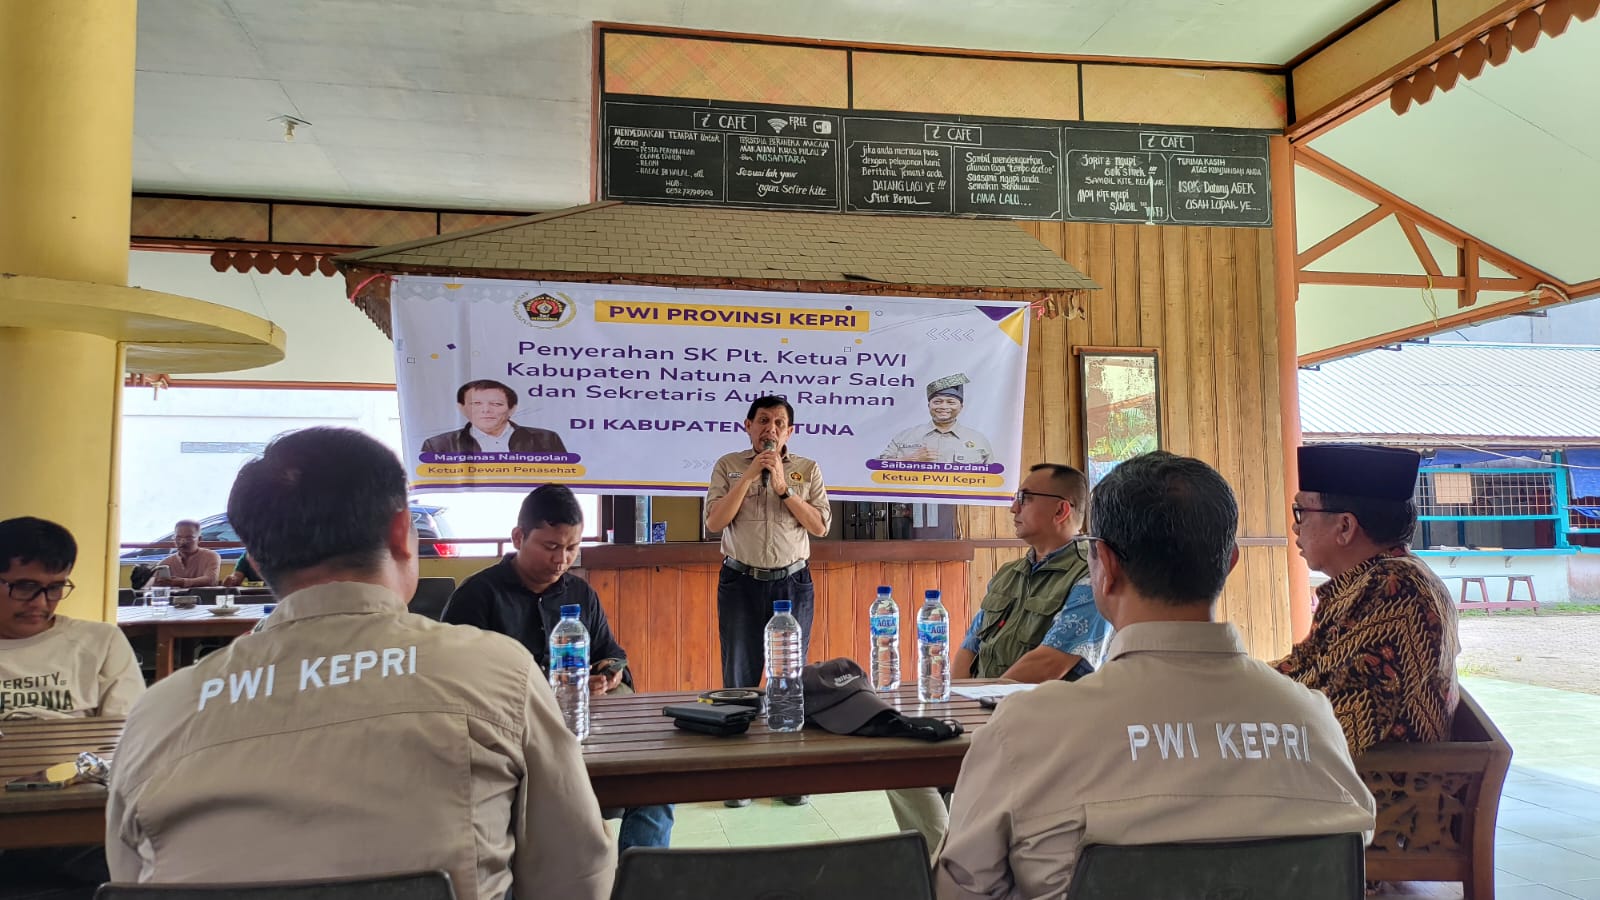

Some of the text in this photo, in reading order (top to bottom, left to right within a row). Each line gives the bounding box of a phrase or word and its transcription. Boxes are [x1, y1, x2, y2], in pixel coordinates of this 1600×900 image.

[719, 115, 748, 130] CAFE
[789, 116, 808, 130] FREE
[614, 128, 664, 139] MENYEDIAKAN
[668, 131, 698, 141] TEMPAT
[947, 128, 973, 141] CAFE
[803, 140, 830, 149] MACAM
[1160, 136, 1186, 149] CAFE
[1203, 158, 1226, 167] KASIH
[1191, 166, 1208, 174] ATAS
[872, 180, 905, 191] DATANG
[905, 181, 923, 193] LAGI
[925, 182, 936, 193] YE
[609, 305, 856, 328] PWI PROVINSI KEPRI
[518, 340, 906, 368] Penyerahan SK Plt. Ketua PWI
[507, 362, 915, 388] Kabupaten Natuna Anwar Saleh
[528, 384, 576, 398] dan
[586, 385, 716, 402] Sekretaris
[797, 391, 895, 407] Rahman
[569, 418, 595, 430] DI
[603, 418, 747, 434] KABUPATEN
[434, 453, 568, 463] Marganas Nainggolan
[428, 465, 577, 475] Ketua Dewan Penasehat
[880, 461, 989, 473] Saibansah Dardani
[882, 473, 987, 485] Ketua PWI Kepri
[0, 671, 60, 690] ERSITY
[198, 645, 417, 712] PWI KEPRI
[1127, 722, 1311, 764] PWI KEPRI
